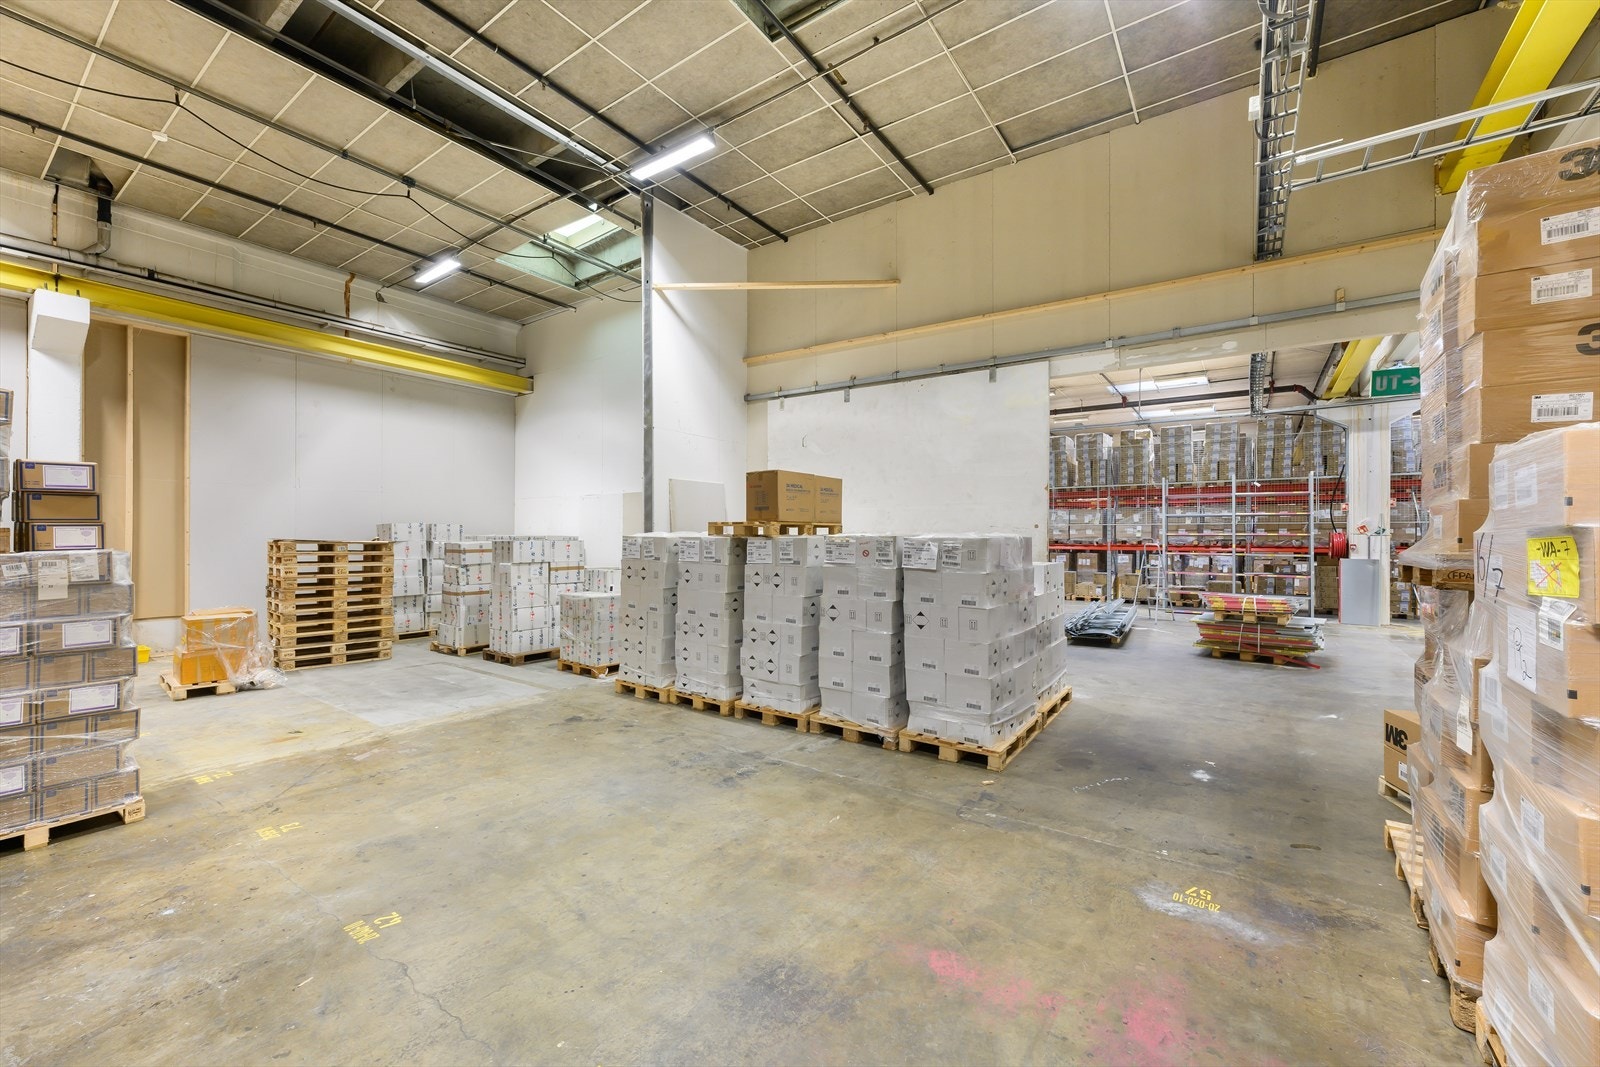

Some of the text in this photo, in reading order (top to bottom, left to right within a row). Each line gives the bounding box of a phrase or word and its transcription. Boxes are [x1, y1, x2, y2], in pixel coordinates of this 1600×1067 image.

[1558, 147, 1600, 181] 3
[1376, 374, 1402, 391] UT
[1385, 722, 1408, 750] 3M
[1173, 893, 1221, 913] 20-020-10
[1184, 886, 1212, 901] 57
